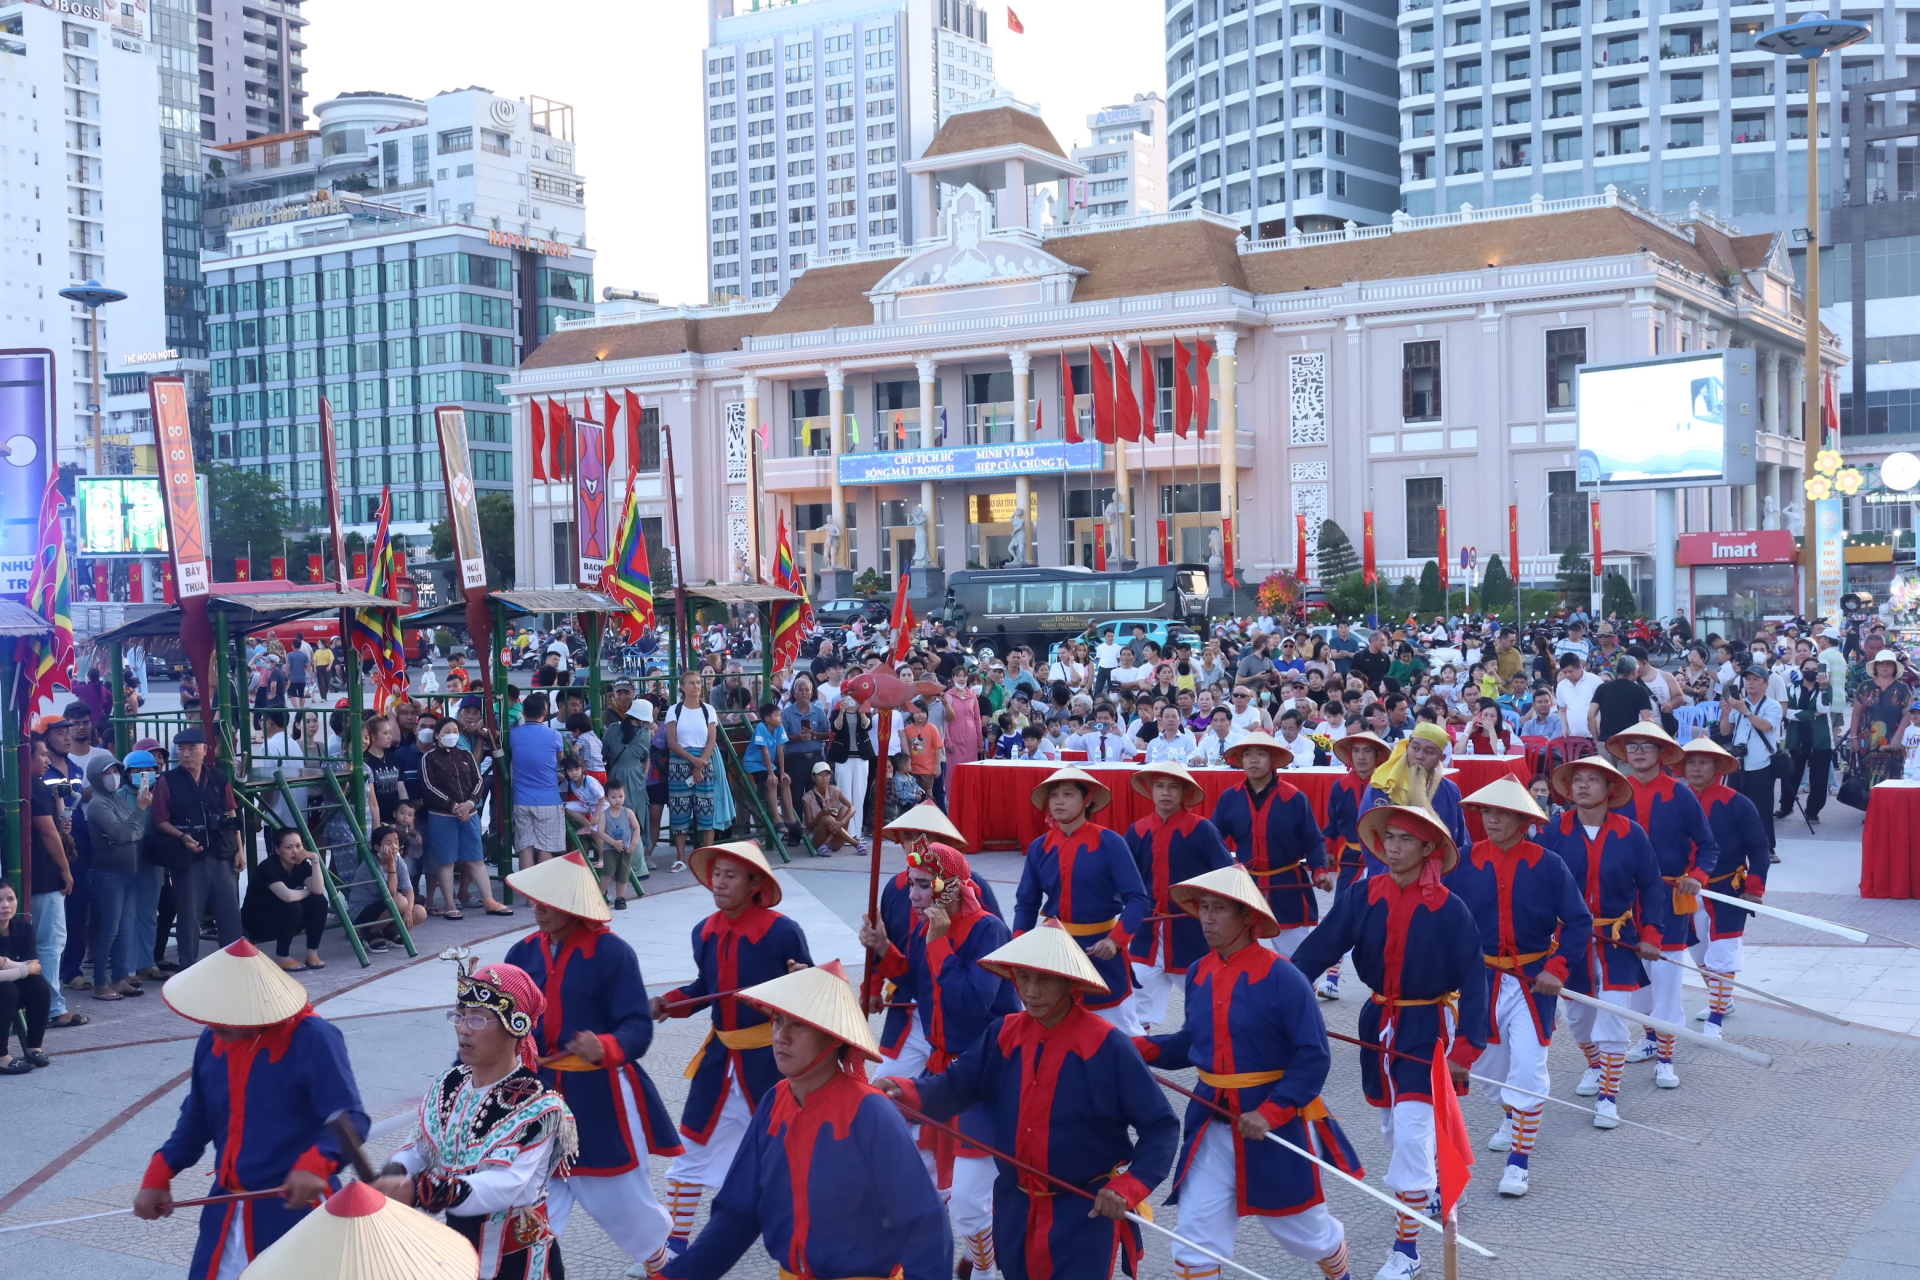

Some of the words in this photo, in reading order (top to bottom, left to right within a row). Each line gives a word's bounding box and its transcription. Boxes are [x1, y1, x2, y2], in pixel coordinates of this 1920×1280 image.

[60, 0, 100, 19] BOSS
[1095, 107, 1141, 125] Atlantic
[232, 211, 268, 230] HAPPY
[271, 204, 303, 224] LIGHT
[307, 199, 344, 218] HOTEL
[488, 229, 531, 252] HAPPY
[537, 237, 573, 259] LIGHT
[124, 353, 136, 363] THE
[138, 351, 157, 361] MOON
[159, 349, 178, 359] HOTEL
[916, 454, 939, 465] TỊCH
[975, 449, 1002, 459] MINH
[1017, 447, 1034, 459] ĐẠI
[997, 459, 1018, 470] CỦA
[1019, 457, 1054, 469] CHÚNG
[1056, 457, 1069, 466] TA
[892, 466, 910, 477] MÃI
[911, 465, 944, 476] TRONG
[1712, 541, 1758, 558] Imart
[693, 638, 700, 646] 04
[502, 652, 510, 662] 03
